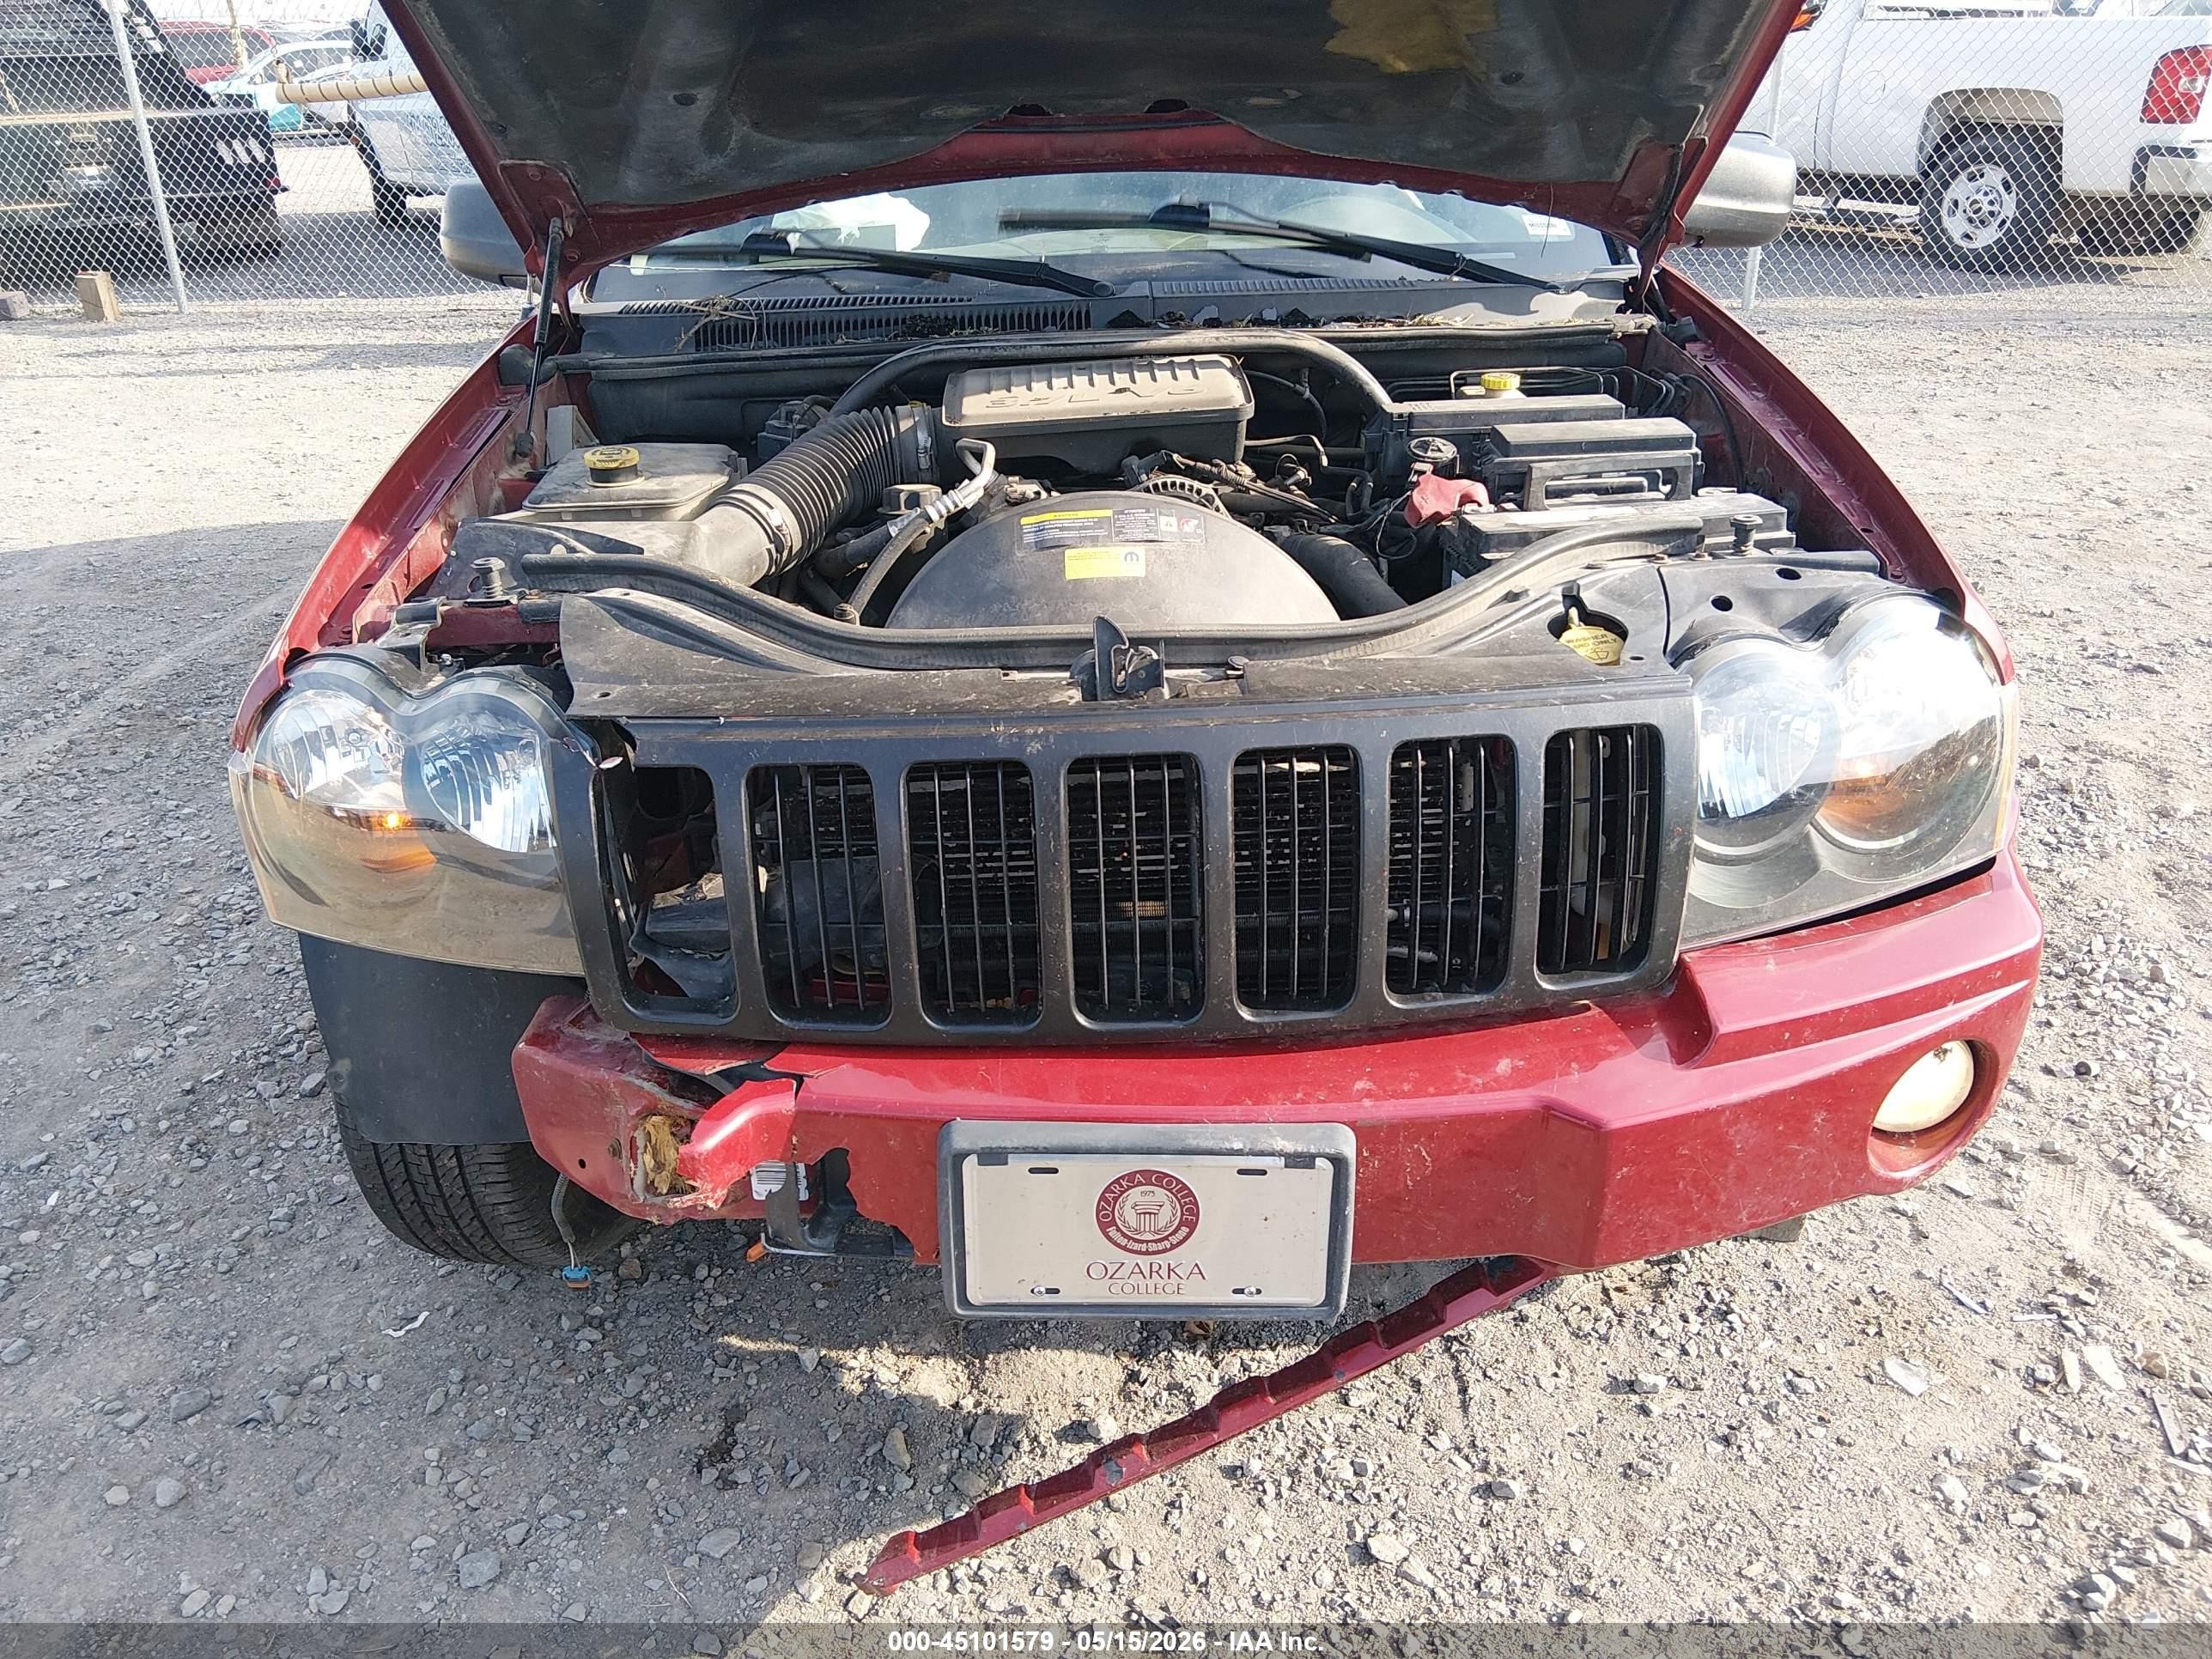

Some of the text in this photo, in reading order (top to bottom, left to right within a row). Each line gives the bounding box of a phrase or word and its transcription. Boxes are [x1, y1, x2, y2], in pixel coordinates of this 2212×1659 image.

[1593, 638, 1618, 647] ONLY
[1098, 1173, 1197, 1223] OZARKA COLLEGE
[1085, 1261, 1207, 1280] OZARKA
[1108, 1282, 1186, 1295] COLLEGE
